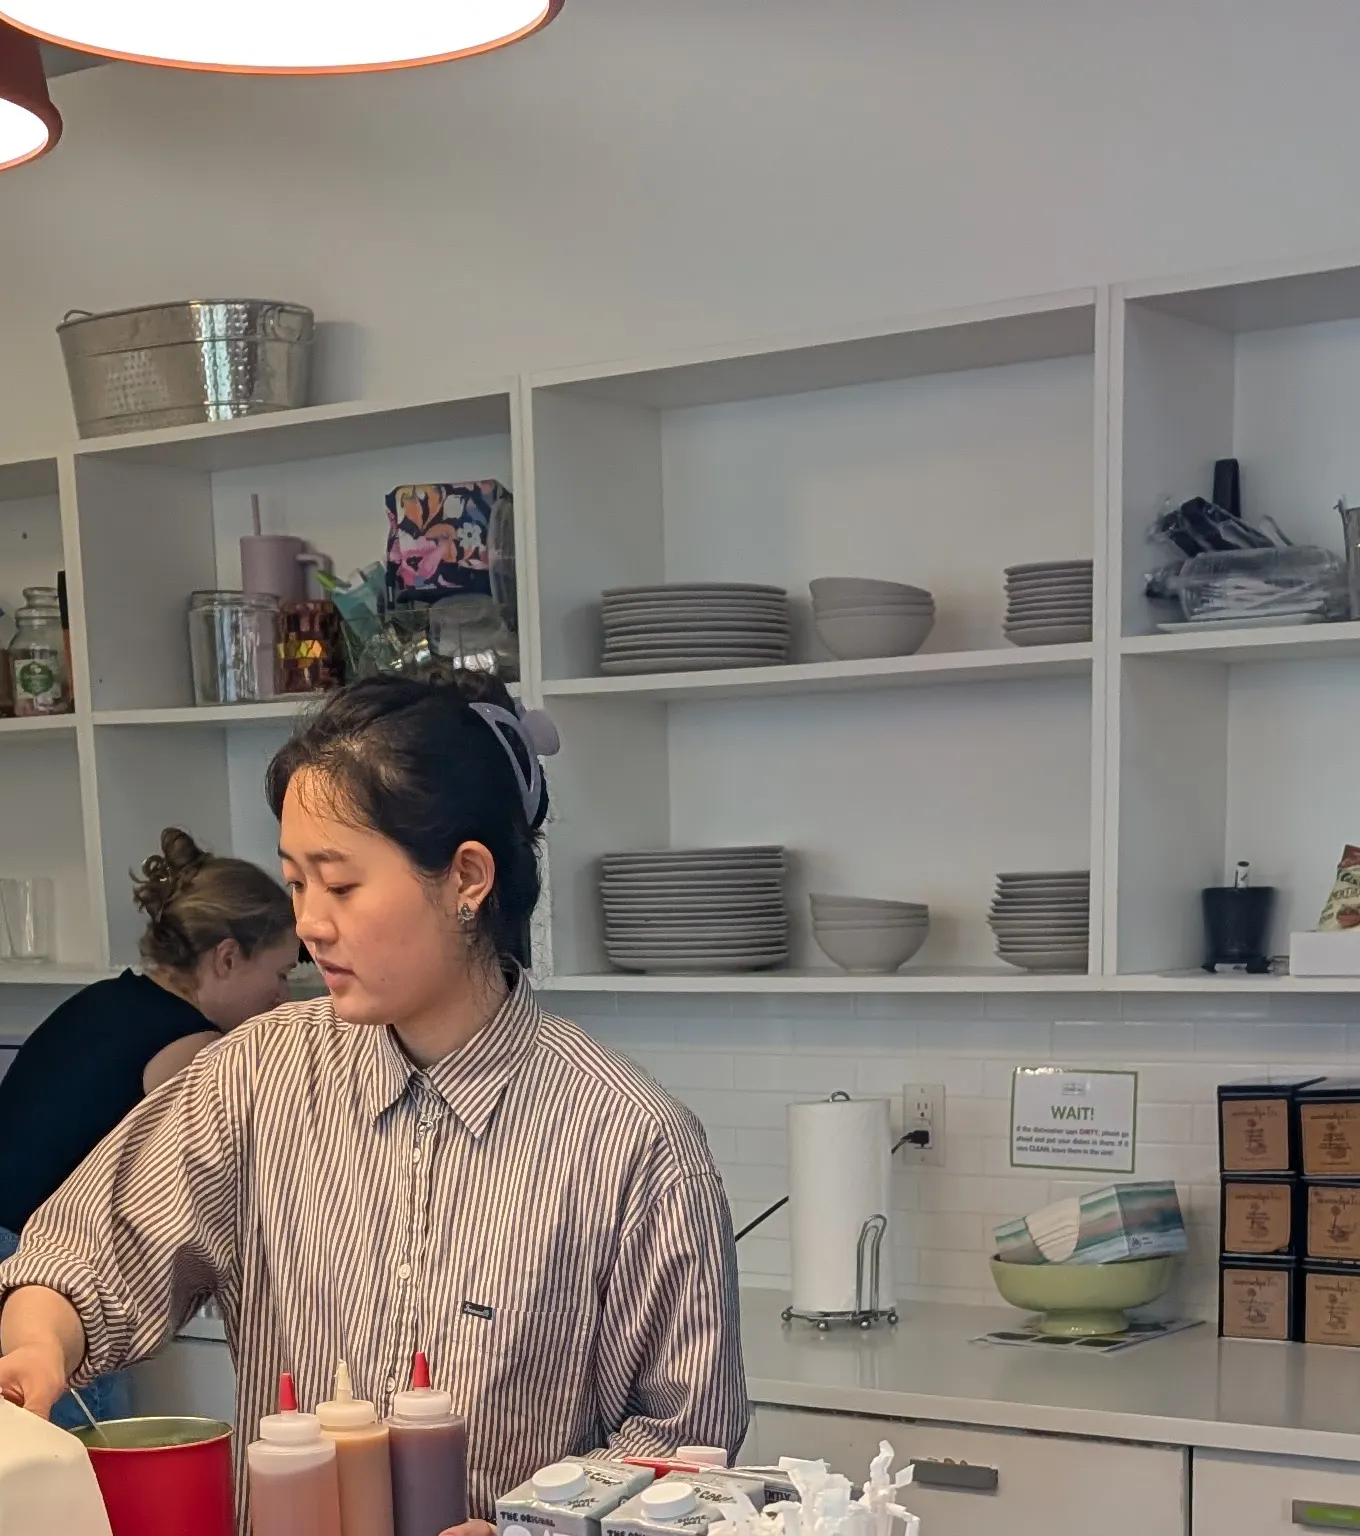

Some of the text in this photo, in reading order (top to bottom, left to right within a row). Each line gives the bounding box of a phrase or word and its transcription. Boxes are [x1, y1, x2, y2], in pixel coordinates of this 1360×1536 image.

[1051, 1106, 1094, 1121] WAIT!
[500, 1511, 556, 1527] THE ORIGINAL
